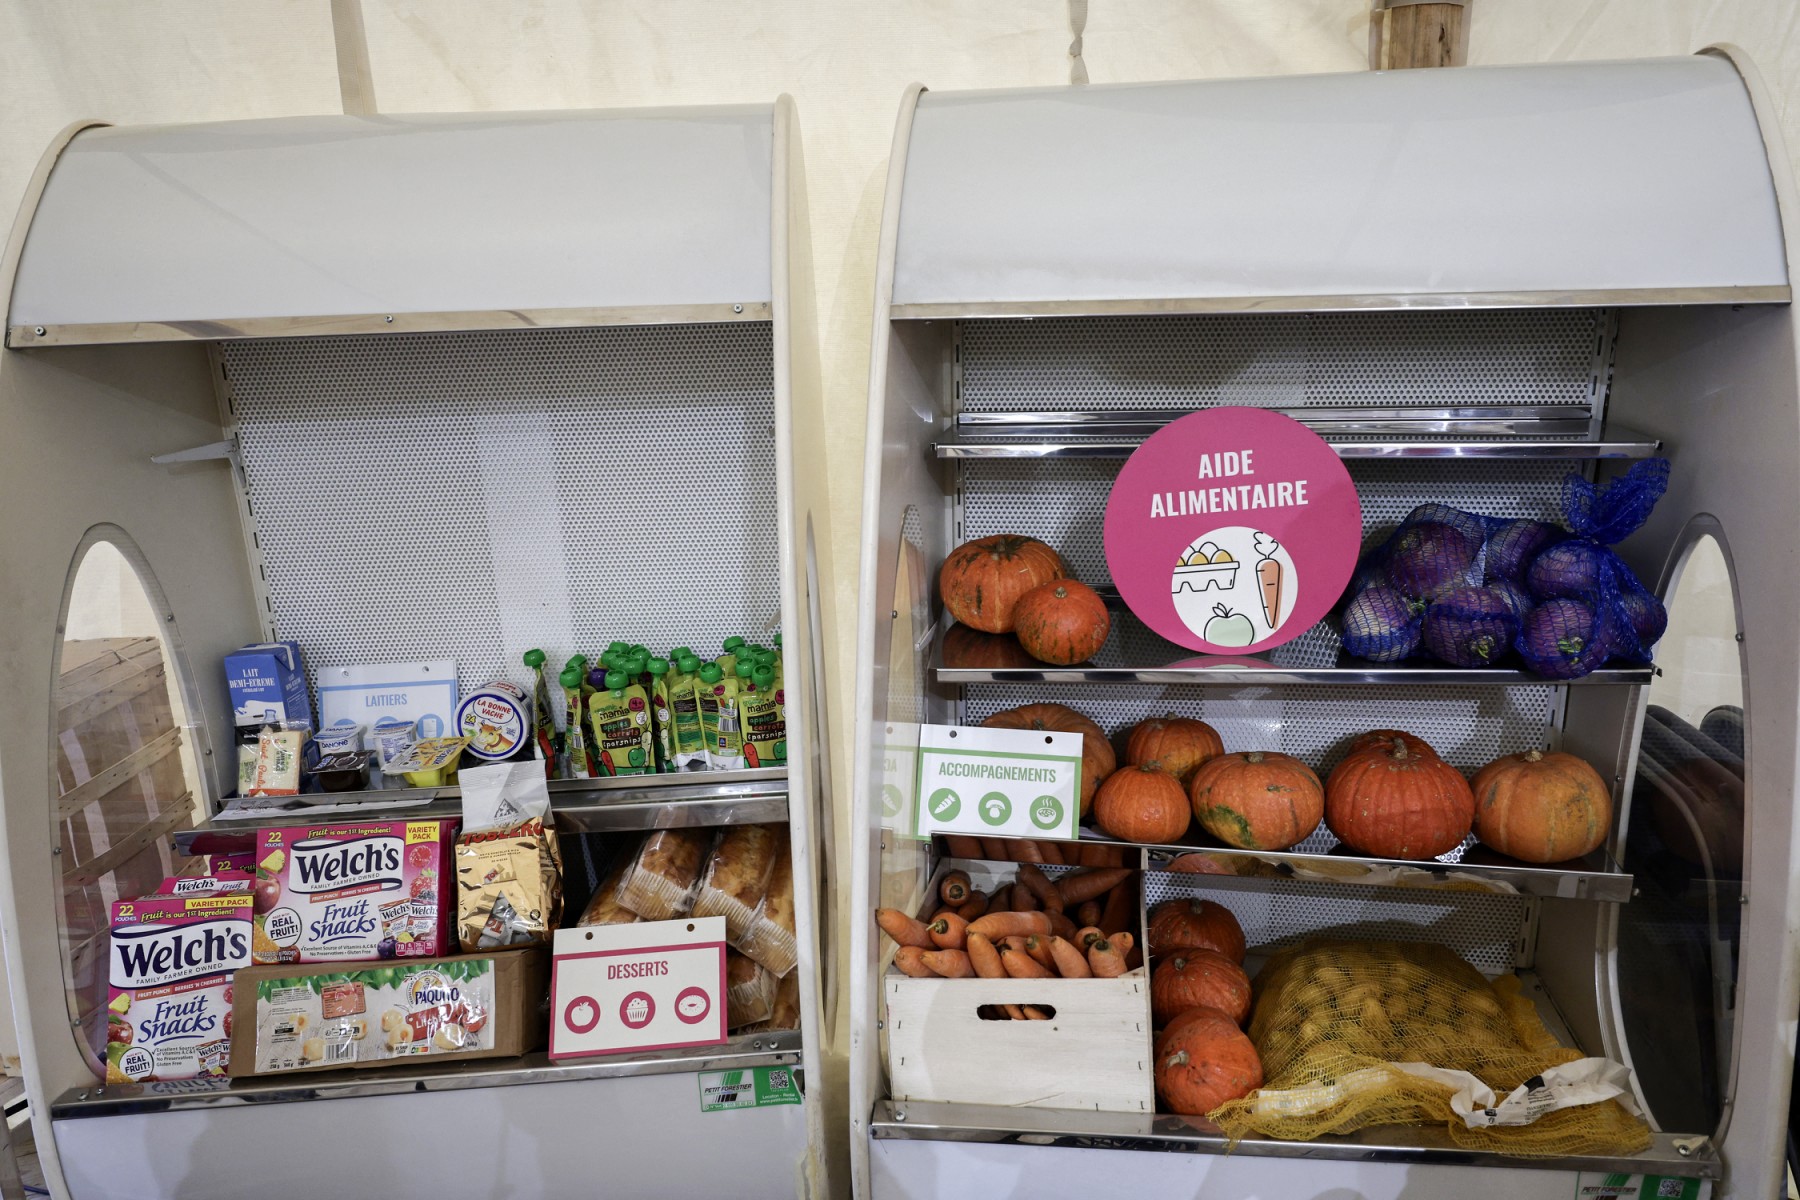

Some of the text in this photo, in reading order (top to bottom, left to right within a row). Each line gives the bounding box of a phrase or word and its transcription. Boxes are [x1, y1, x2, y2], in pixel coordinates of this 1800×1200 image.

[1198, 450, 1254, 479] AIDE
[1150, 480, 1308, 518] ALIMENTAIRE
[242, 668, 258, 678] LAIT
[366, 693, 408, 708] LAITIERS
[748, 699, 776, 713] mamia
[482, 708, 504, 720] VACHE
[488, 702, 512, 714] BONNE
[600, 706, 630, 720] mamia
[465, 714, 476, 723] 24
[750, 714, 774, 724] apples
[602, 721, 628, 732] apples
[608, 729, 639, 738] carrots
[322, 740, 348, 748] DANONE
[938, 762, 1056, 783] ACCOMPAGNEMENTS
[268, 832, 282, 843] 22
[308, 828, 328, 839] Fruit
[358, 827, 391, 836] Ingredient!
[217, 860, 231, 870] 22
[294, 843, 399, 884] Welch's
[178, 880, 215, 891] Welch's
[333, 878, 356, 886] FARMER
[358, 873, 380, 881] OWNED
[220, 882, 243, 891] Fruit
[191, 900, 225, 908] VARIETY
[119, 905, 134, 916] 22
[140, 911, 164, 922] Fruit
[198, 909, 235, 917] Ingredient!
[322, 898, 369, 924] Fruit
[272, 916, 294, 928] REAL
[309, 914, 376, 942] Snacks
[270, 925, 298, 938] FRUIT!
[116, 927, 247, 978] Welch's
[136, 963, 223, 984] FAMILY FARMER OWNED
[607, 960, 668, 980] DESSERTS
[200, 978, 223, 986] CHERRIES
[153, 988, 170, 996] PUNCH
[153, 995, 208, 1024] Fruit
[138, 1012, 216, 1043] Snacks
[126, 1055, 146, 1065] REAL
[125, 1062, 150, 1074] FRUIT!
